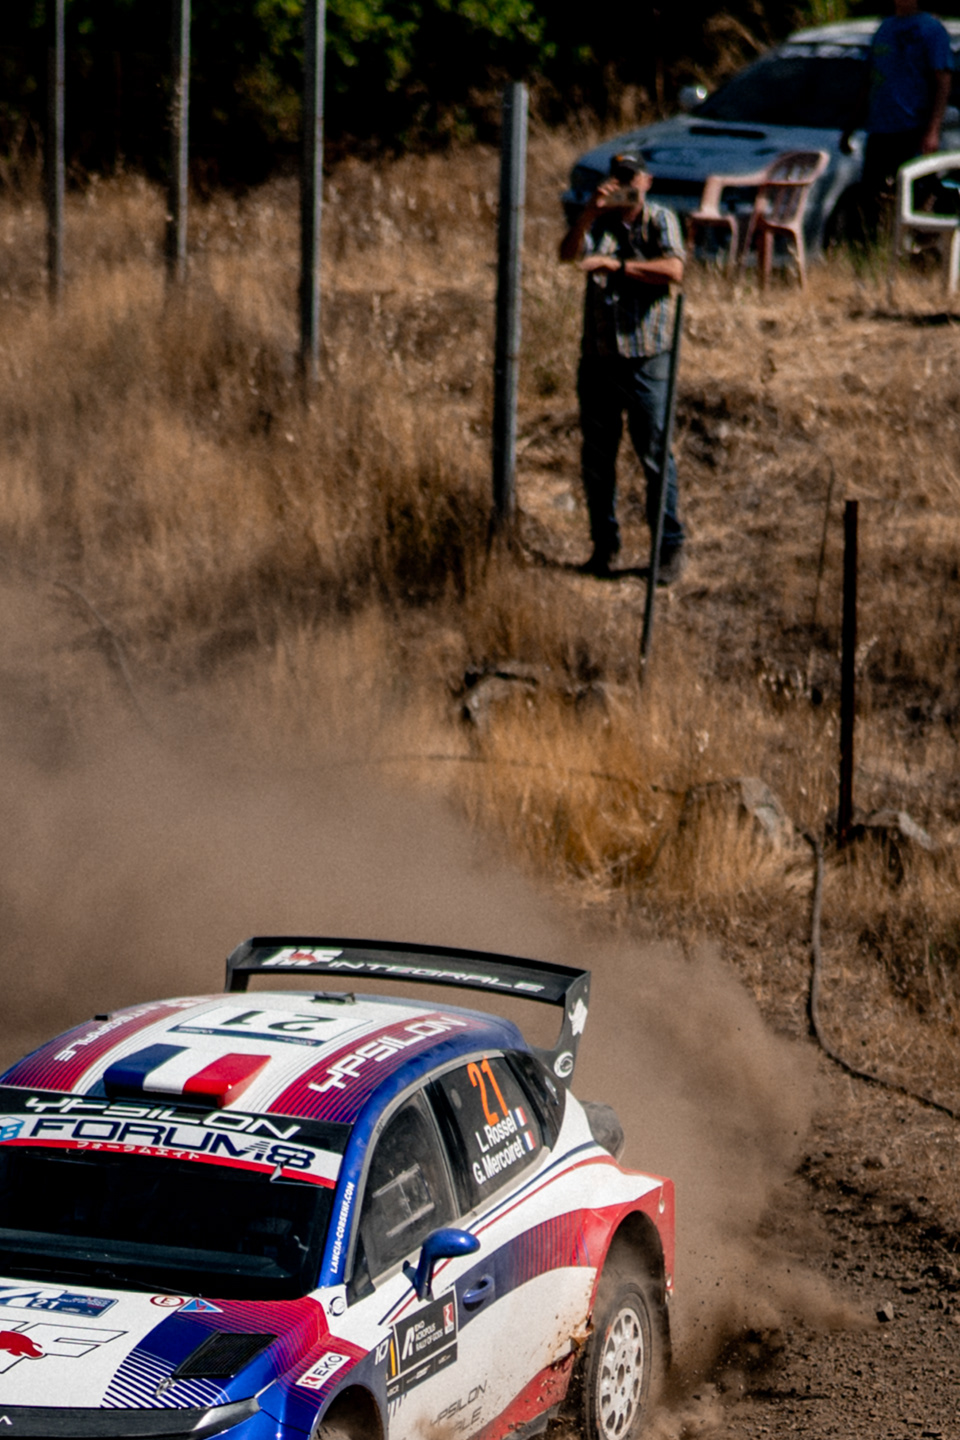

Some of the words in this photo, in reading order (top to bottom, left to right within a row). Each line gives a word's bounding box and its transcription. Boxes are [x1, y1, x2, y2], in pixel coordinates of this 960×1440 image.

[328, 960, 545, 992] INTEGRALE
[220, 1010, 338, 1032] 21
[308, 1015, 467, 1093] YPSILON
[467, 1056, 508, 1127] 21
[25, 1097, 301, 1139] YPSILON
[475, 1131, 490, 1153] L.
[484, 1109, 518, 1143] Rossel
[29, 1117, 317, 1170] FORUM8
[76, 1140, 200, 1160] フォーラムエイト
[472, 1161, 487, 1184] G.
[482, 1135, 526, 1179] Mercoiret
[30, 1299, 60, 1310] 21
[312, 1355, 343, 1377] EKO
